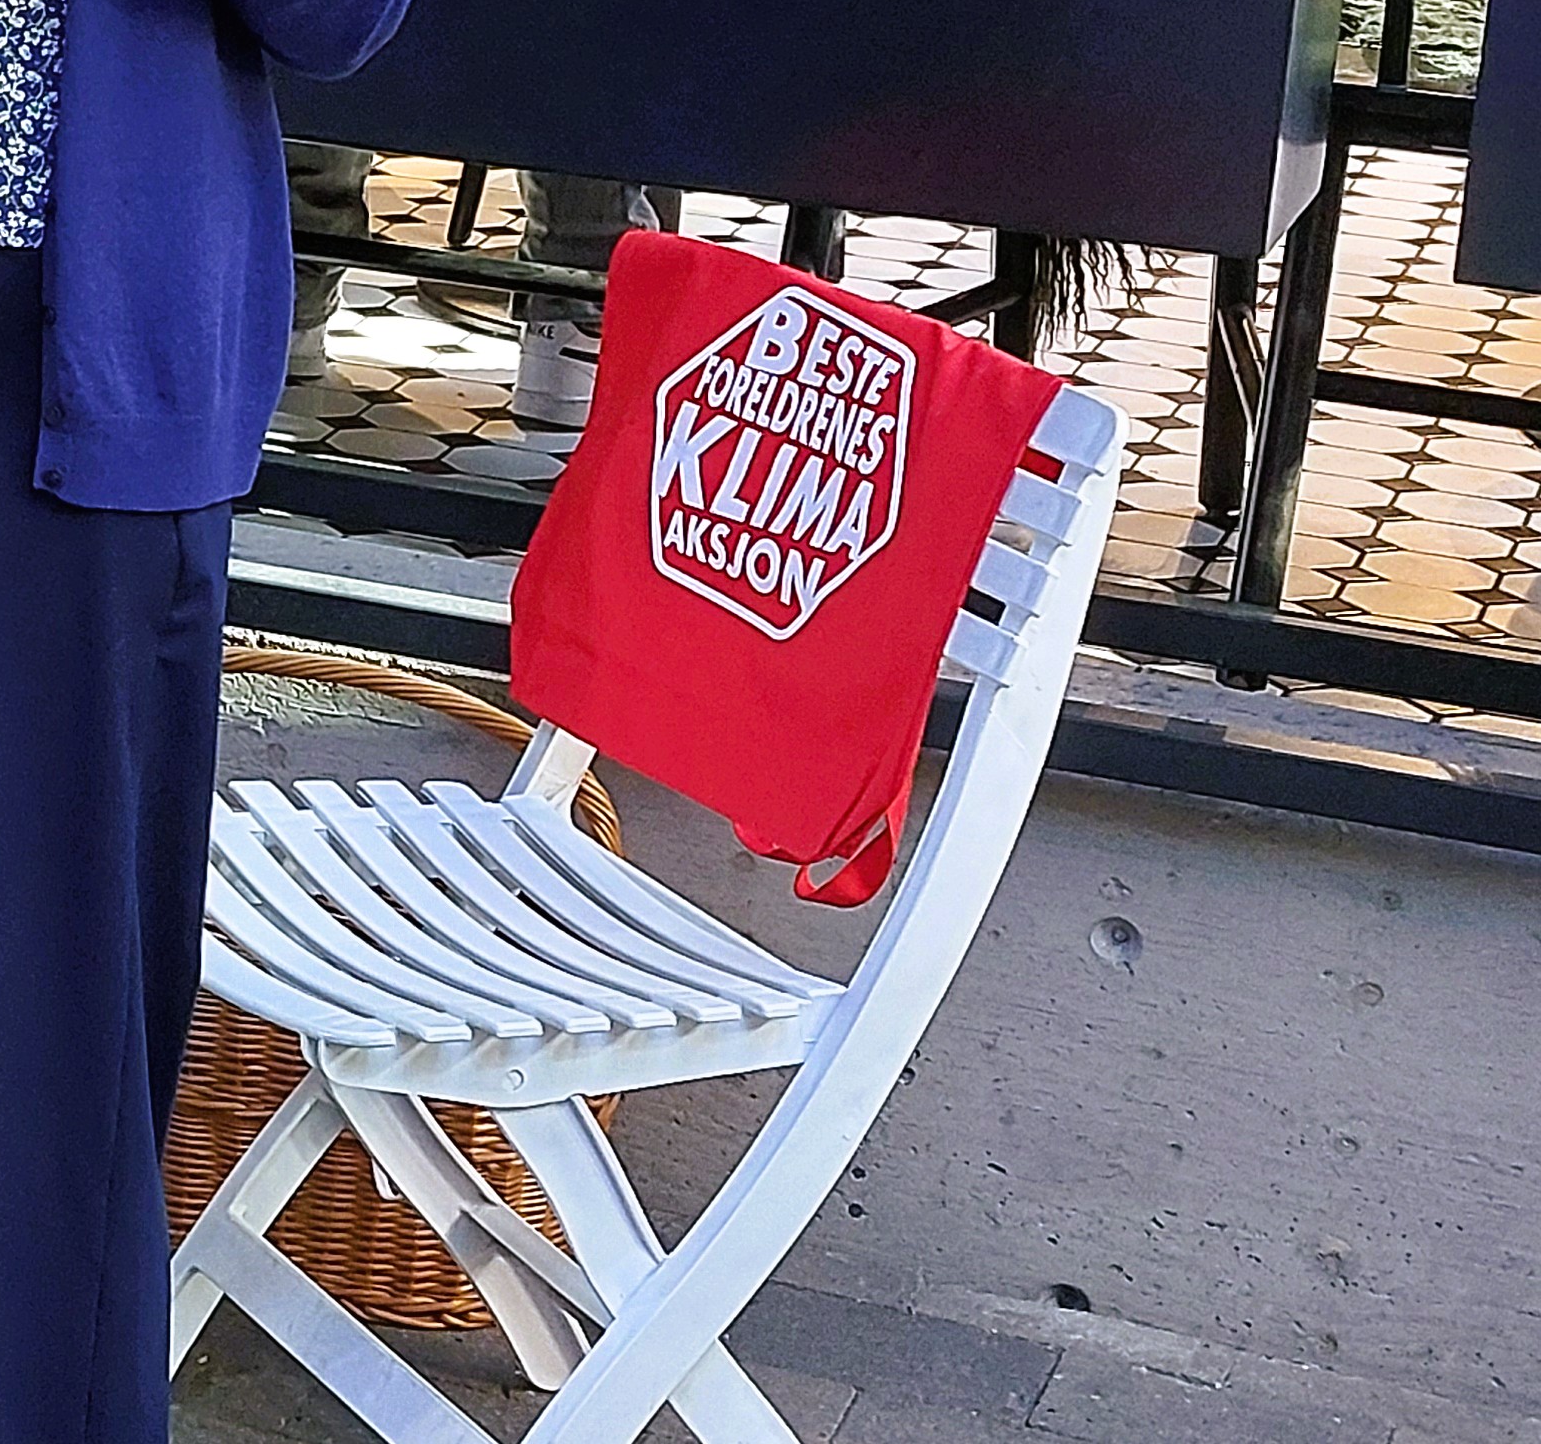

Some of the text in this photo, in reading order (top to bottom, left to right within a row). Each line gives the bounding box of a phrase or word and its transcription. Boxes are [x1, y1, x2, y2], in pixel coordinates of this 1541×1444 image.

[745, 297, 901, 405] BESTE
[693, 355, 896, 475] FORELDRENES
[657, 400, 875, 561] KLIMA
[663, 509, 826, 612] AKSJON
